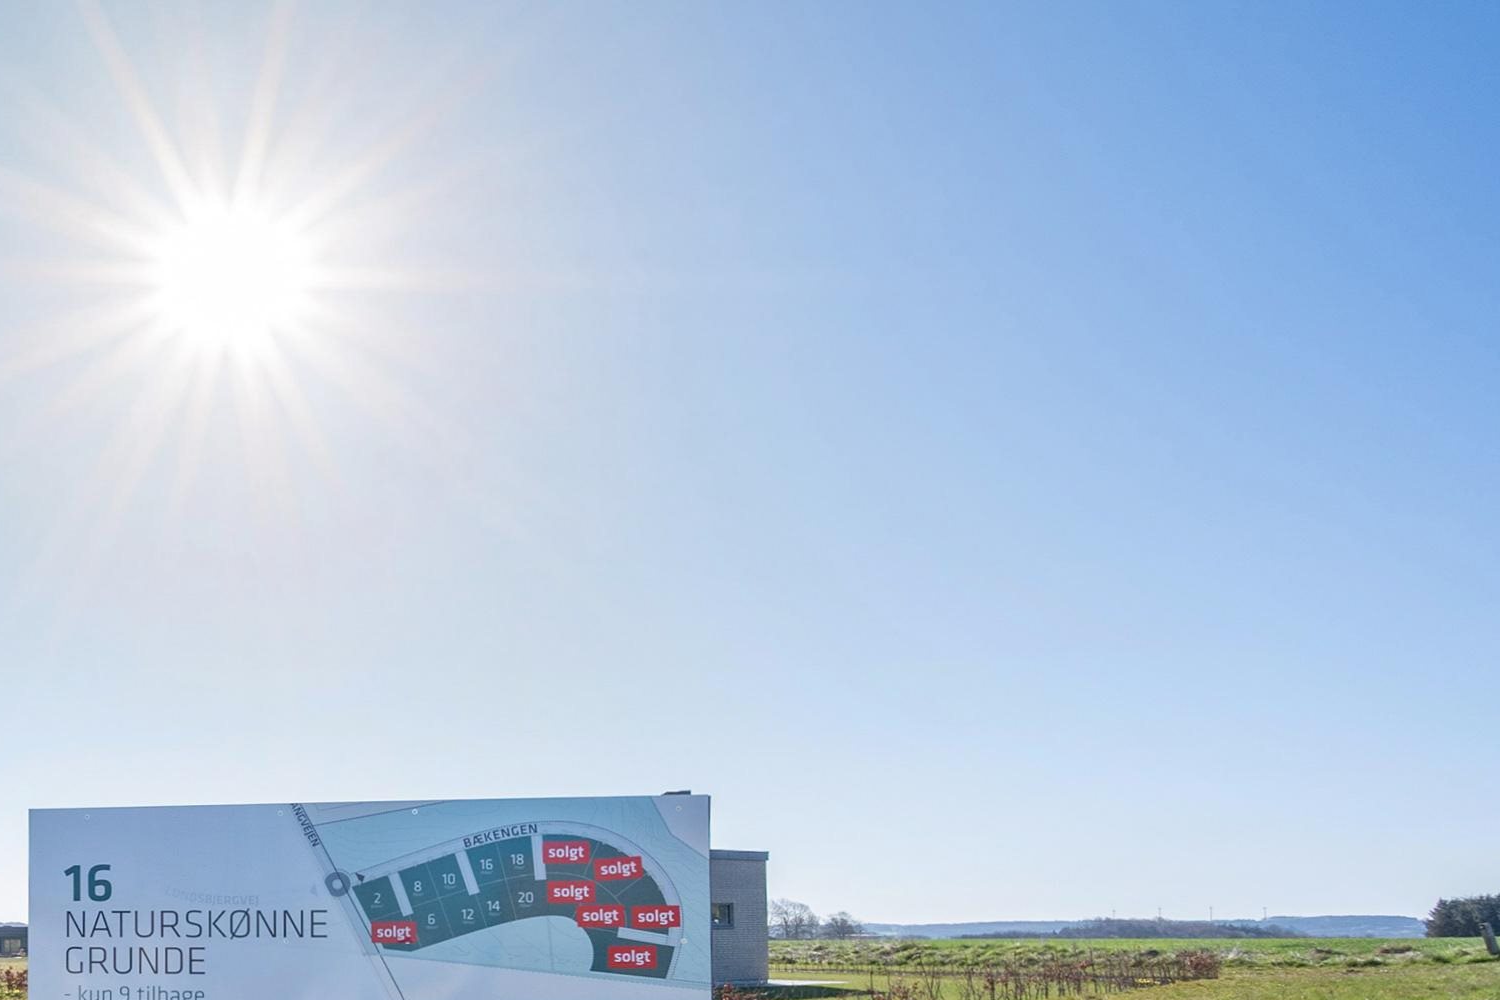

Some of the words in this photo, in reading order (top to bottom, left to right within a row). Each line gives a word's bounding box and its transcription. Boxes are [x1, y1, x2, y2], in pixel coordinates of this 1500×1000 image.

[463, 824, 539, 848] BÆKENGEN
[511, 853, 524, 865] 18
[548, 845, 585, 861] solgt
[480, 858, 493, 871] 16
[600, 861, 638, 877] solgt
[63, 864, 113, 902] 16
[414, 881, 422, 892] 8
[442, 873, 456, 885] 10
[374, 893, 381, 904] 2
[518, 892, 534, 903] 20
[553, 885, 590, 900] solgt
[487, 900, 500, 912] 14
[427, 914, 436, 925] 6
[461, 908, 474, 920] 12
[582, 909, 619, 924] solgt
[638, 909, 675, 925] solgt
[65, 908, 328, 940] NATURSKØNNE
[376, 926, 412, 943] solgt
[65, 946, 206, 975] GRUNDE
[614, 950, 651, 965] solgt
